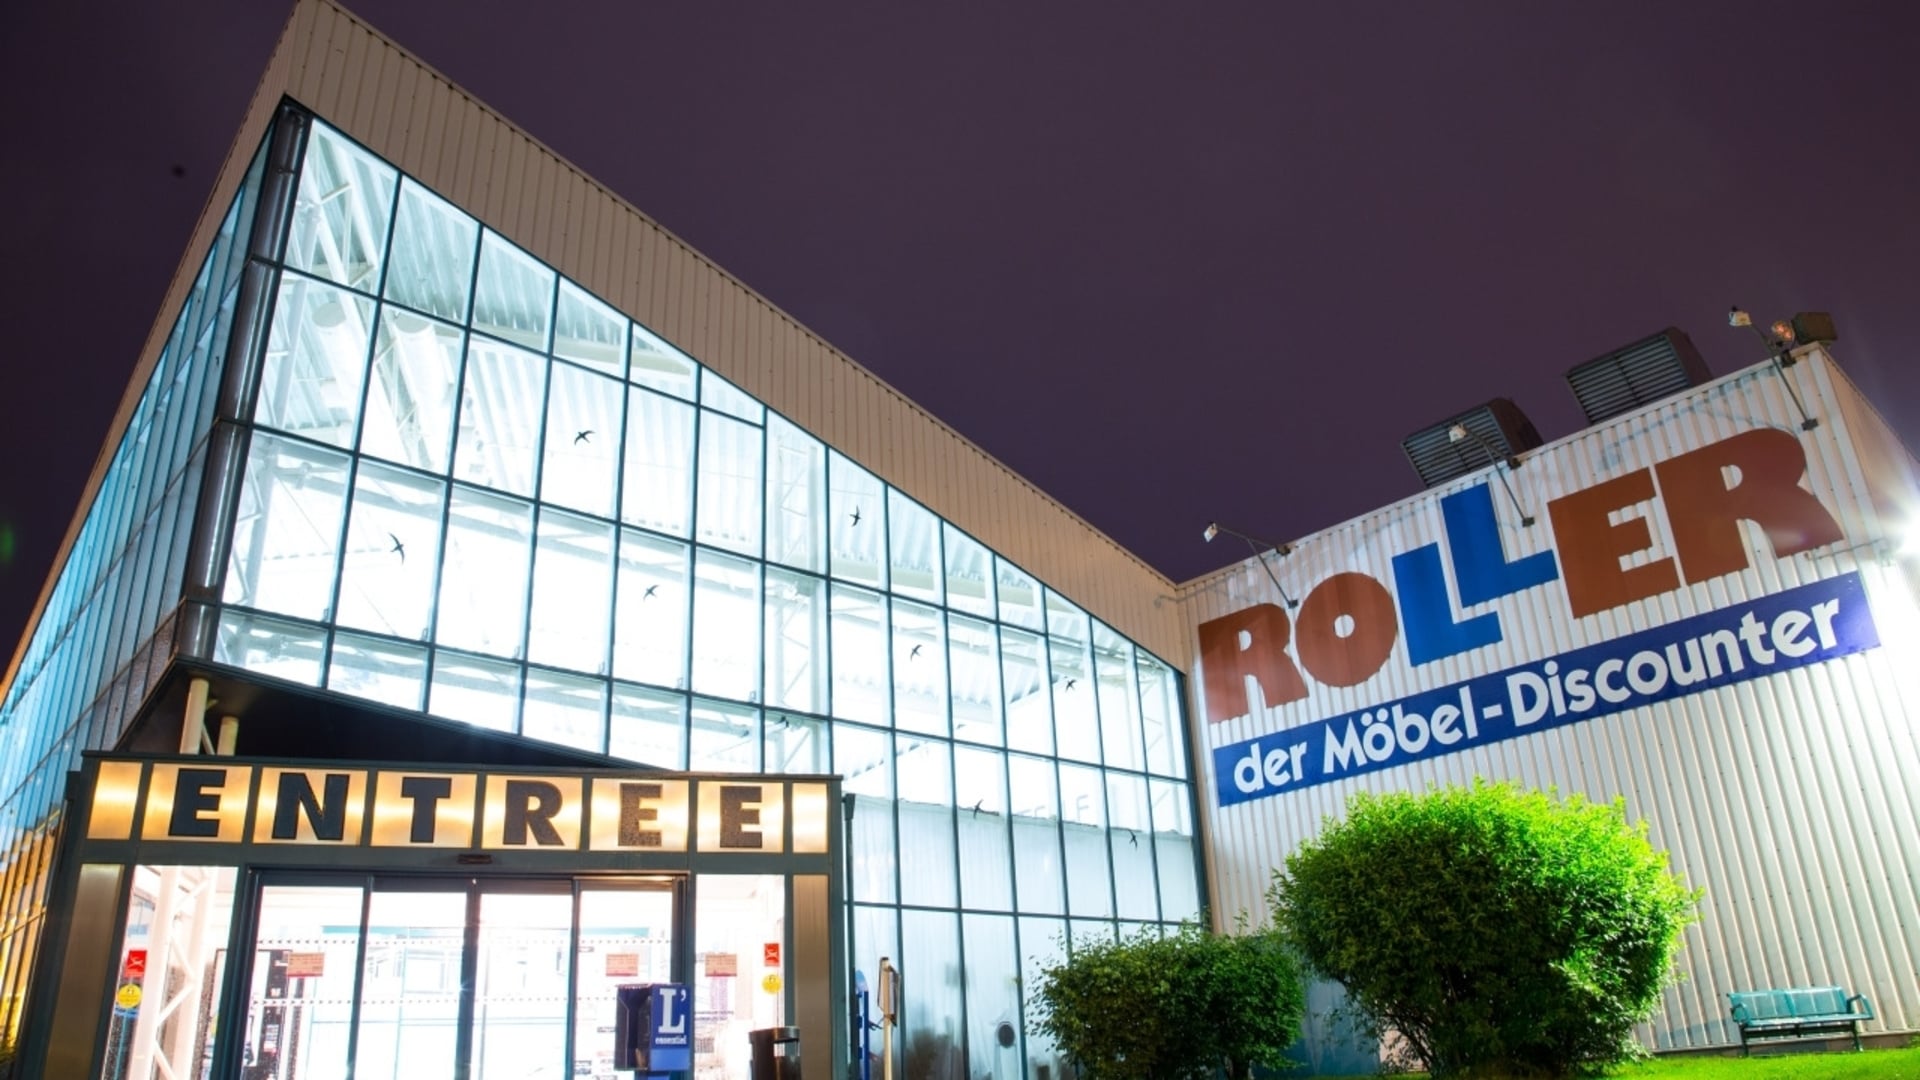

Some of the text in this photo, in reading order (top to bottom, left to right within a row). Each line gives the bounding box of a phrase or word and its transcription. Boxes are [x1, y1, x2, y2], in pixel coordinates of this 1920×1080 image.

[1199, 428, 1845, 724] ROLLER
[167, 767, 763, 849] ENTREE
[1234, 742, 1307, 793] der
